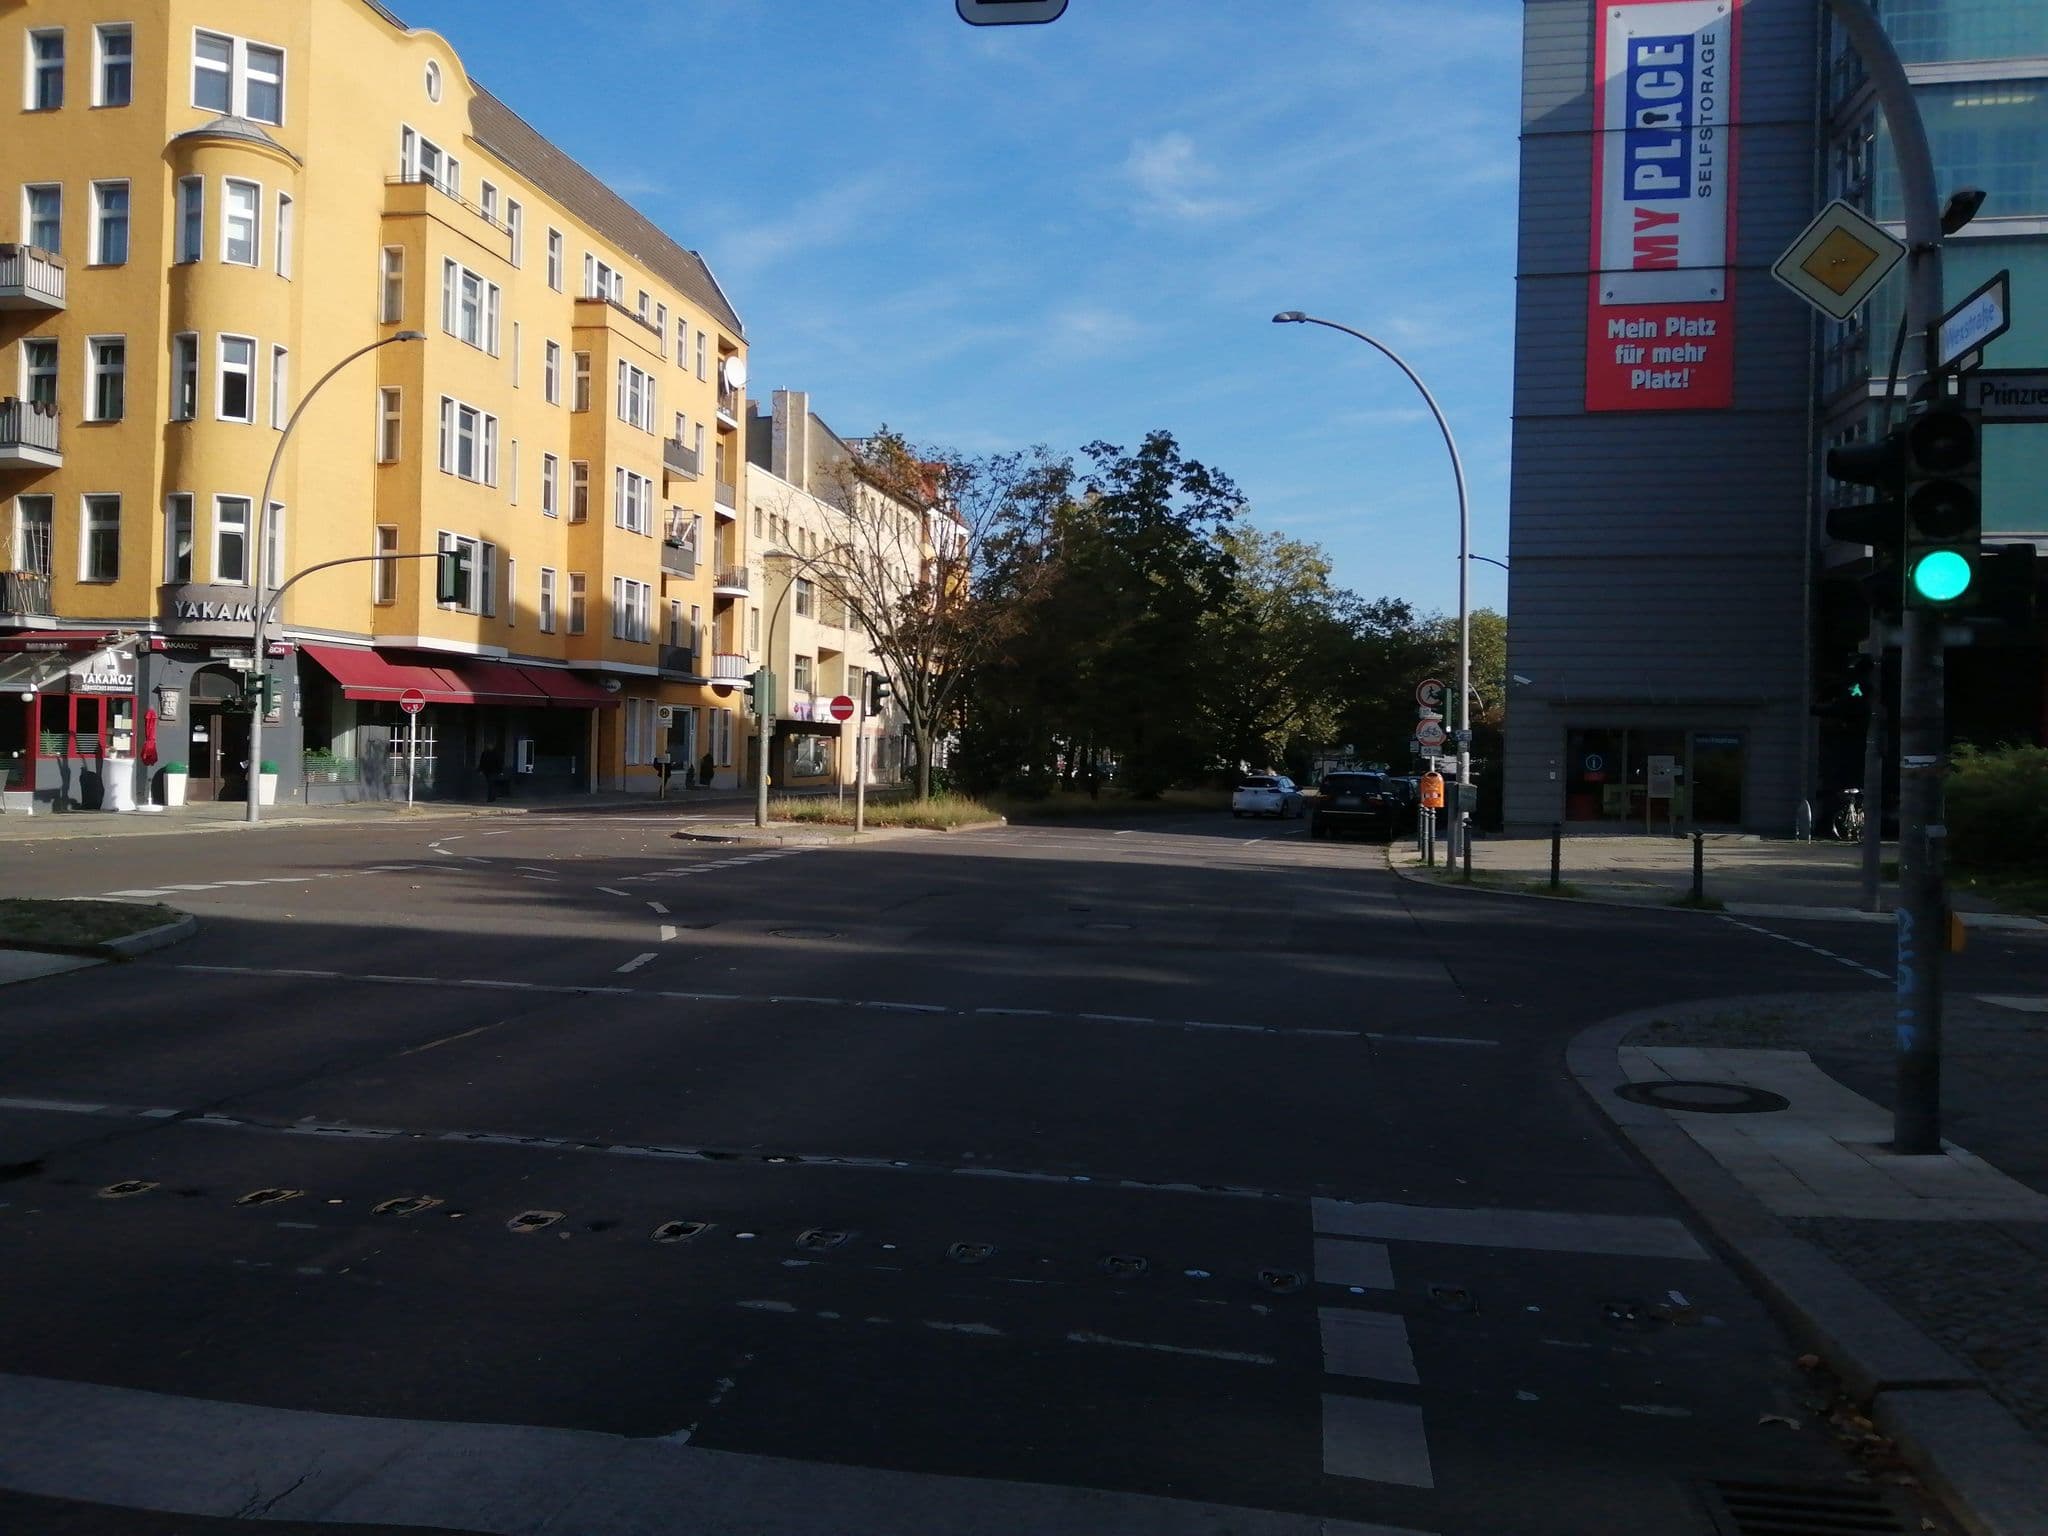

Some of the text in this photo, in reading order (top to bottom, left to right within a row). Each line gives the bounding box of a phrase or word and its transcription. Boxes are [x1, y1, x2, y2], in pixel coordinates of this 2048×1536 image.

[1698, 34, 1715, 197] SELFSTORAGE
[1633, 43, 1684, 272] MY PLACE
[1608, 316, 1716, 338] Mein Platz
[1615, 342, 1707, 364] für mehr
[1631, 368, 1689, 389] Platz!
[161, 641, 199, 650] YAKAMOZ
[81, 672, 133, 685] YAKAMOZ
